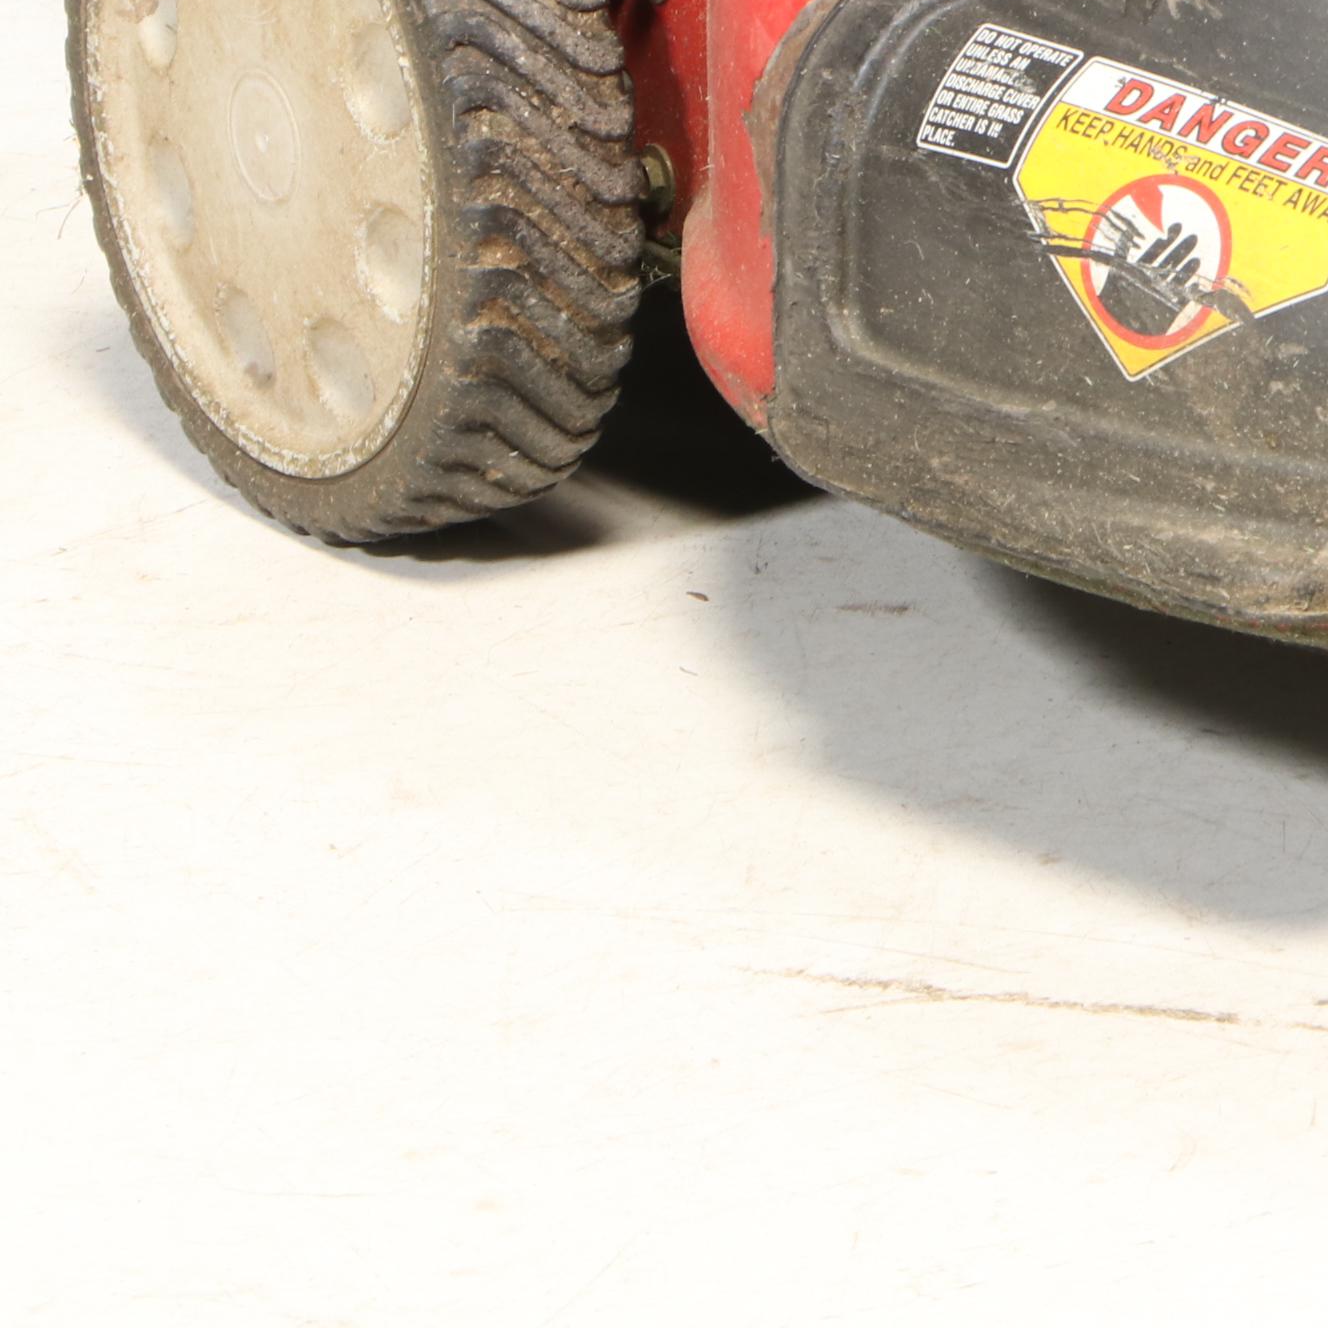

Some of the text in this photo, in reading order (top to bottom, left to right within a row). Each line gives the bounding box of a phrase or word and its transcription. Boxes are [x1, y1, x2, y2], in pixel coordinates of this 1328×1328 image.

[965, 43, 1032, 71] UNLESS AN
[976, 29, 1074, 67] DO NOT OPERATE
[936, 90, 1025, 125] OR ENTIRE GRASS
[945, 73, 1041, 110] DISCHARGE COVER
[921, 124, 957, 147] PLACE.
[928, 106, 975, 131] CATCHER
[975, 118, 989, 135] IS
[1055, 106, 1113, 144] KEEP
[1111, 123, 1188, 166] HANDS
[1186, 151, 1227, 179] and
[1224, 164, 1288, 200] FEET
